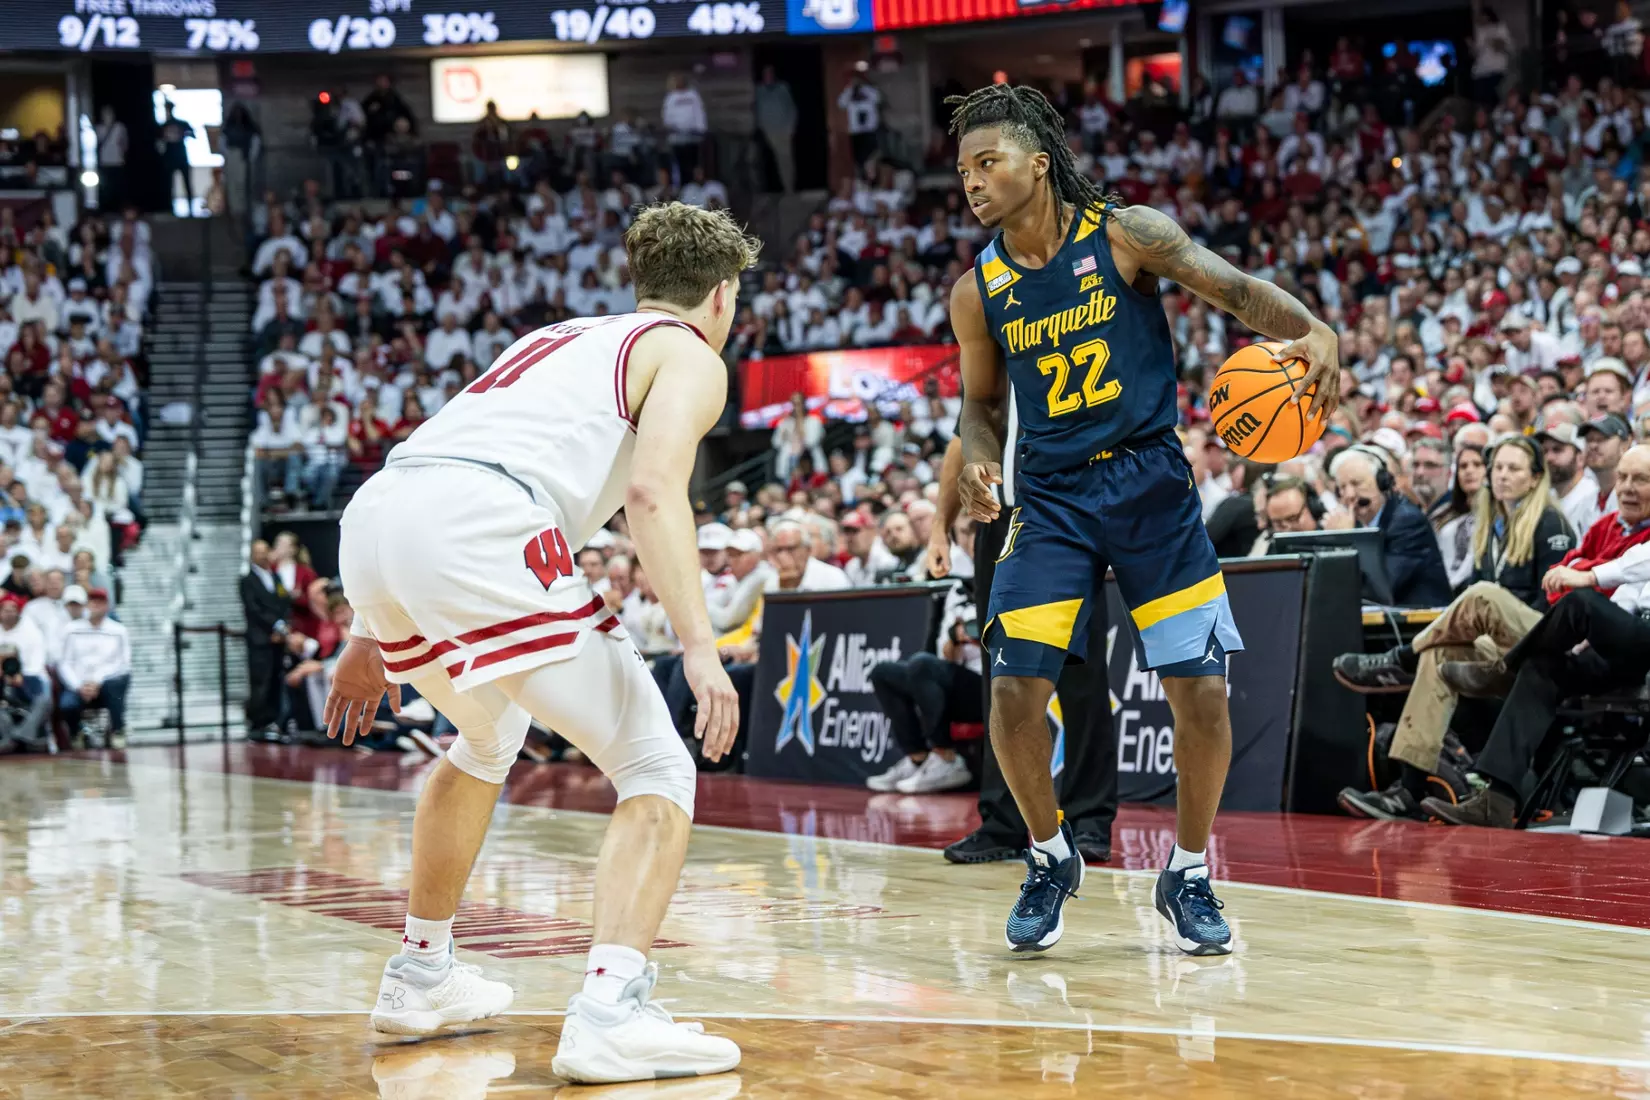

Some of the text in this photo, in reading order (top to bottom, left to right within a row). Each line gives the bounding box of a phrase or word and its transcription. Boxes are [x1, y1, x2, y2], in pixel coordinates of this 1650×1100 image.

[58, 13, 260, 52] 9/12 75%
[308, 11, 500, 54] 6/20 30%
[551, 5, 657, 45] 19/40
[687, 1, 765, 35] 48%
[1001, 288, 1117, 354] Marquette
[465, 331, 584, 394] 11
[1036, 337, 1123, 418] 22
[523, 526, 574, 592] W
